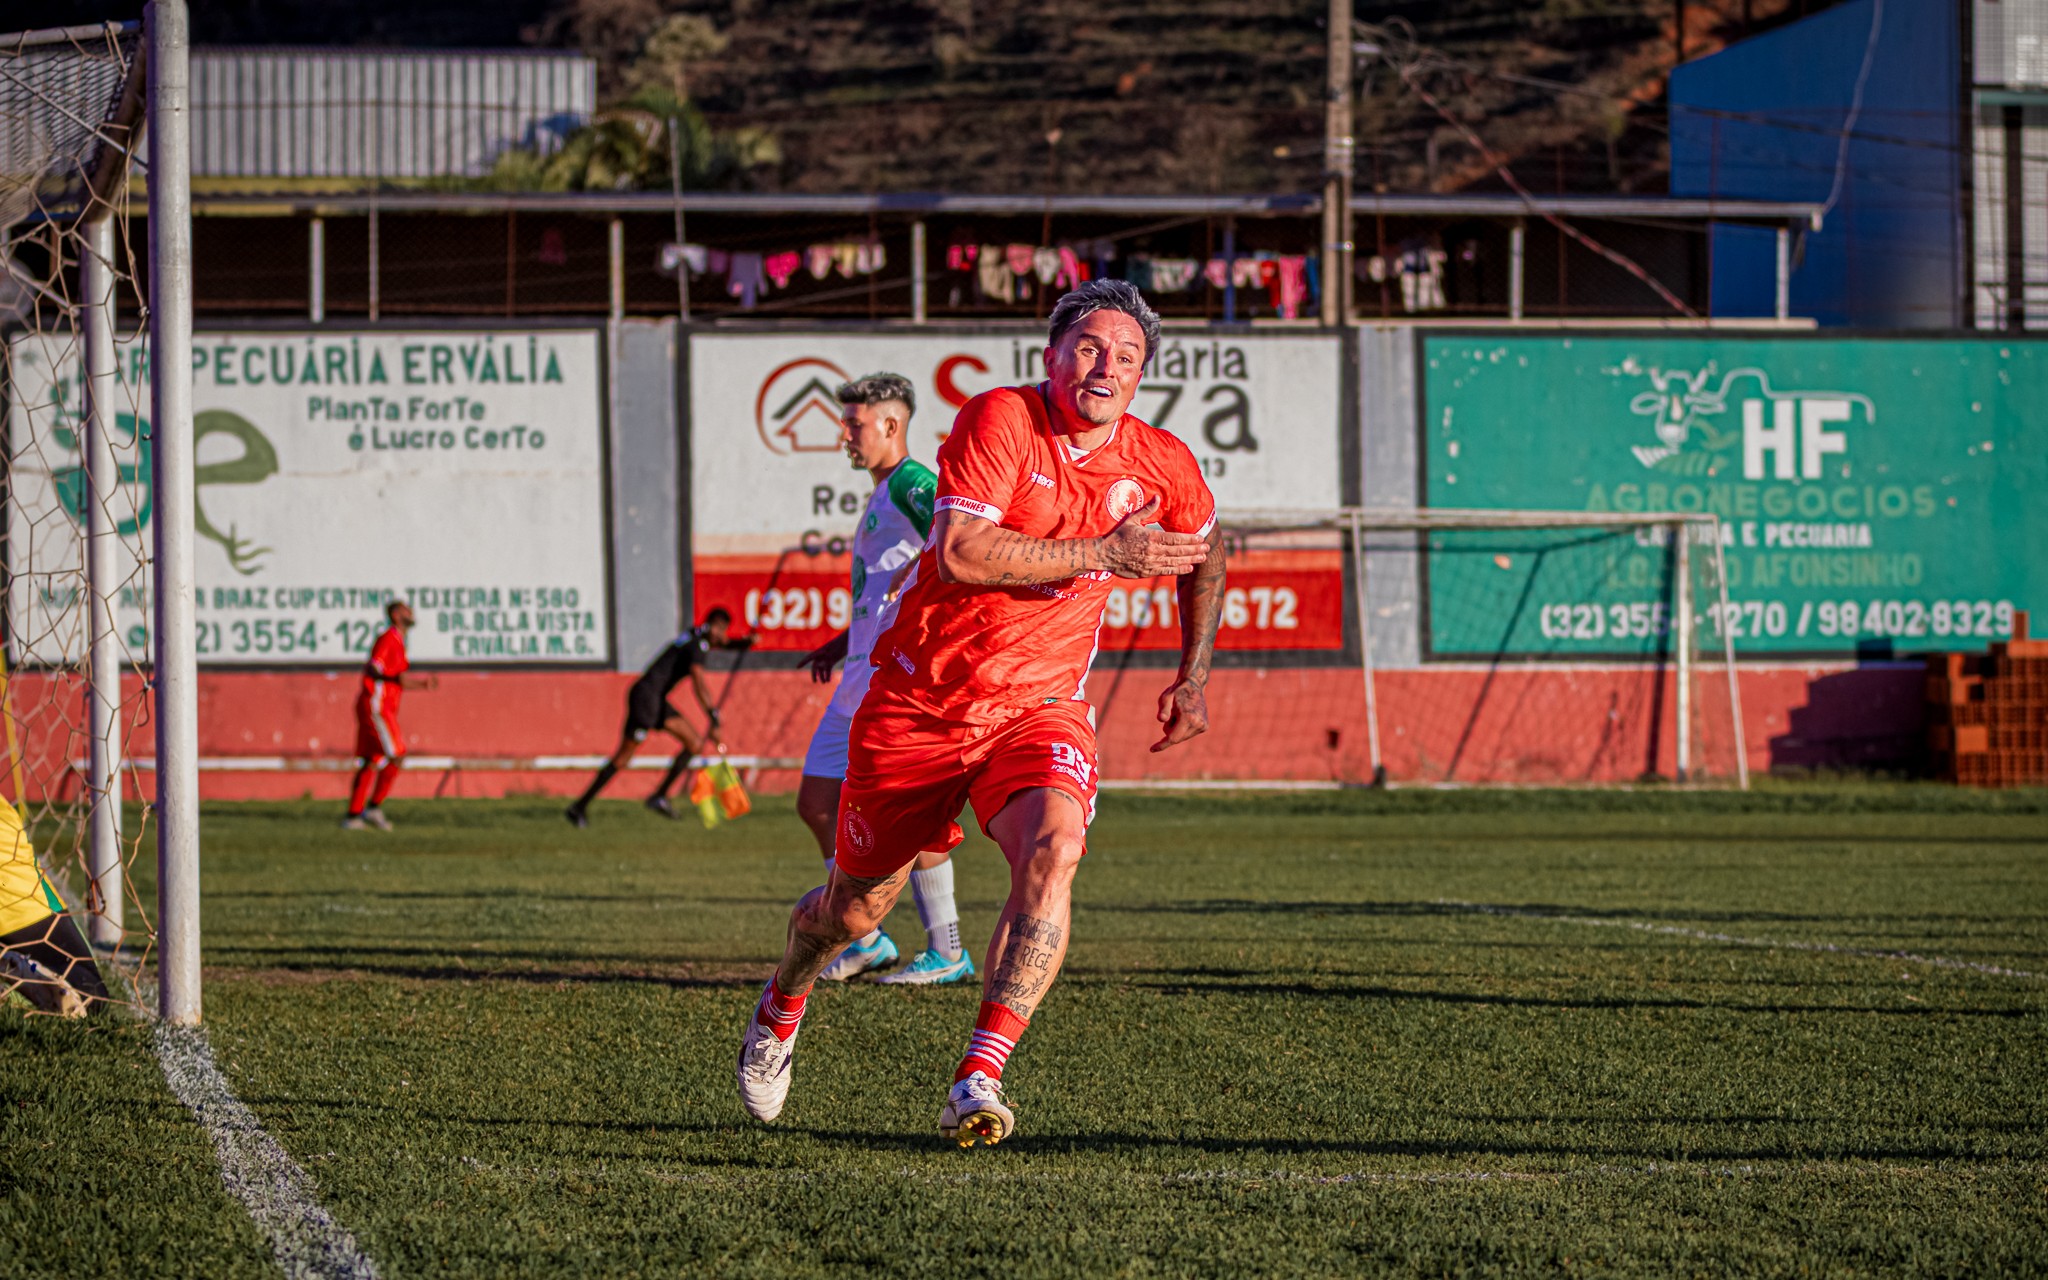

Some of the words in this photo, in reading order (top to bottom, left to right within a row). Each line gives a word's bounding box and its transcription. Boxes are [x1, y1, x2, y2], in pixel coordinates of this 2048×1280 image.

[372, 426, 456, 450] Lucro
[1743, 399, 1851, 480] HF
[1585, 483, 1937, 518] AGRONEGOCIOS
[1741, 521, 1758, 547] E
[1752, 552, 1922, 588] AFONSINHO
[213, 588, 268, 609] BRAZ
[404, 588, 500, 609] TEIXEIRA
[537, 588, 579, 609] 580
[745, 586, 823, 630] (32)
[536, 611, 596, 632] VISTA
[1540, 602, 1605, 640] (32)
[1019, 945, 1052, 971] REGE
